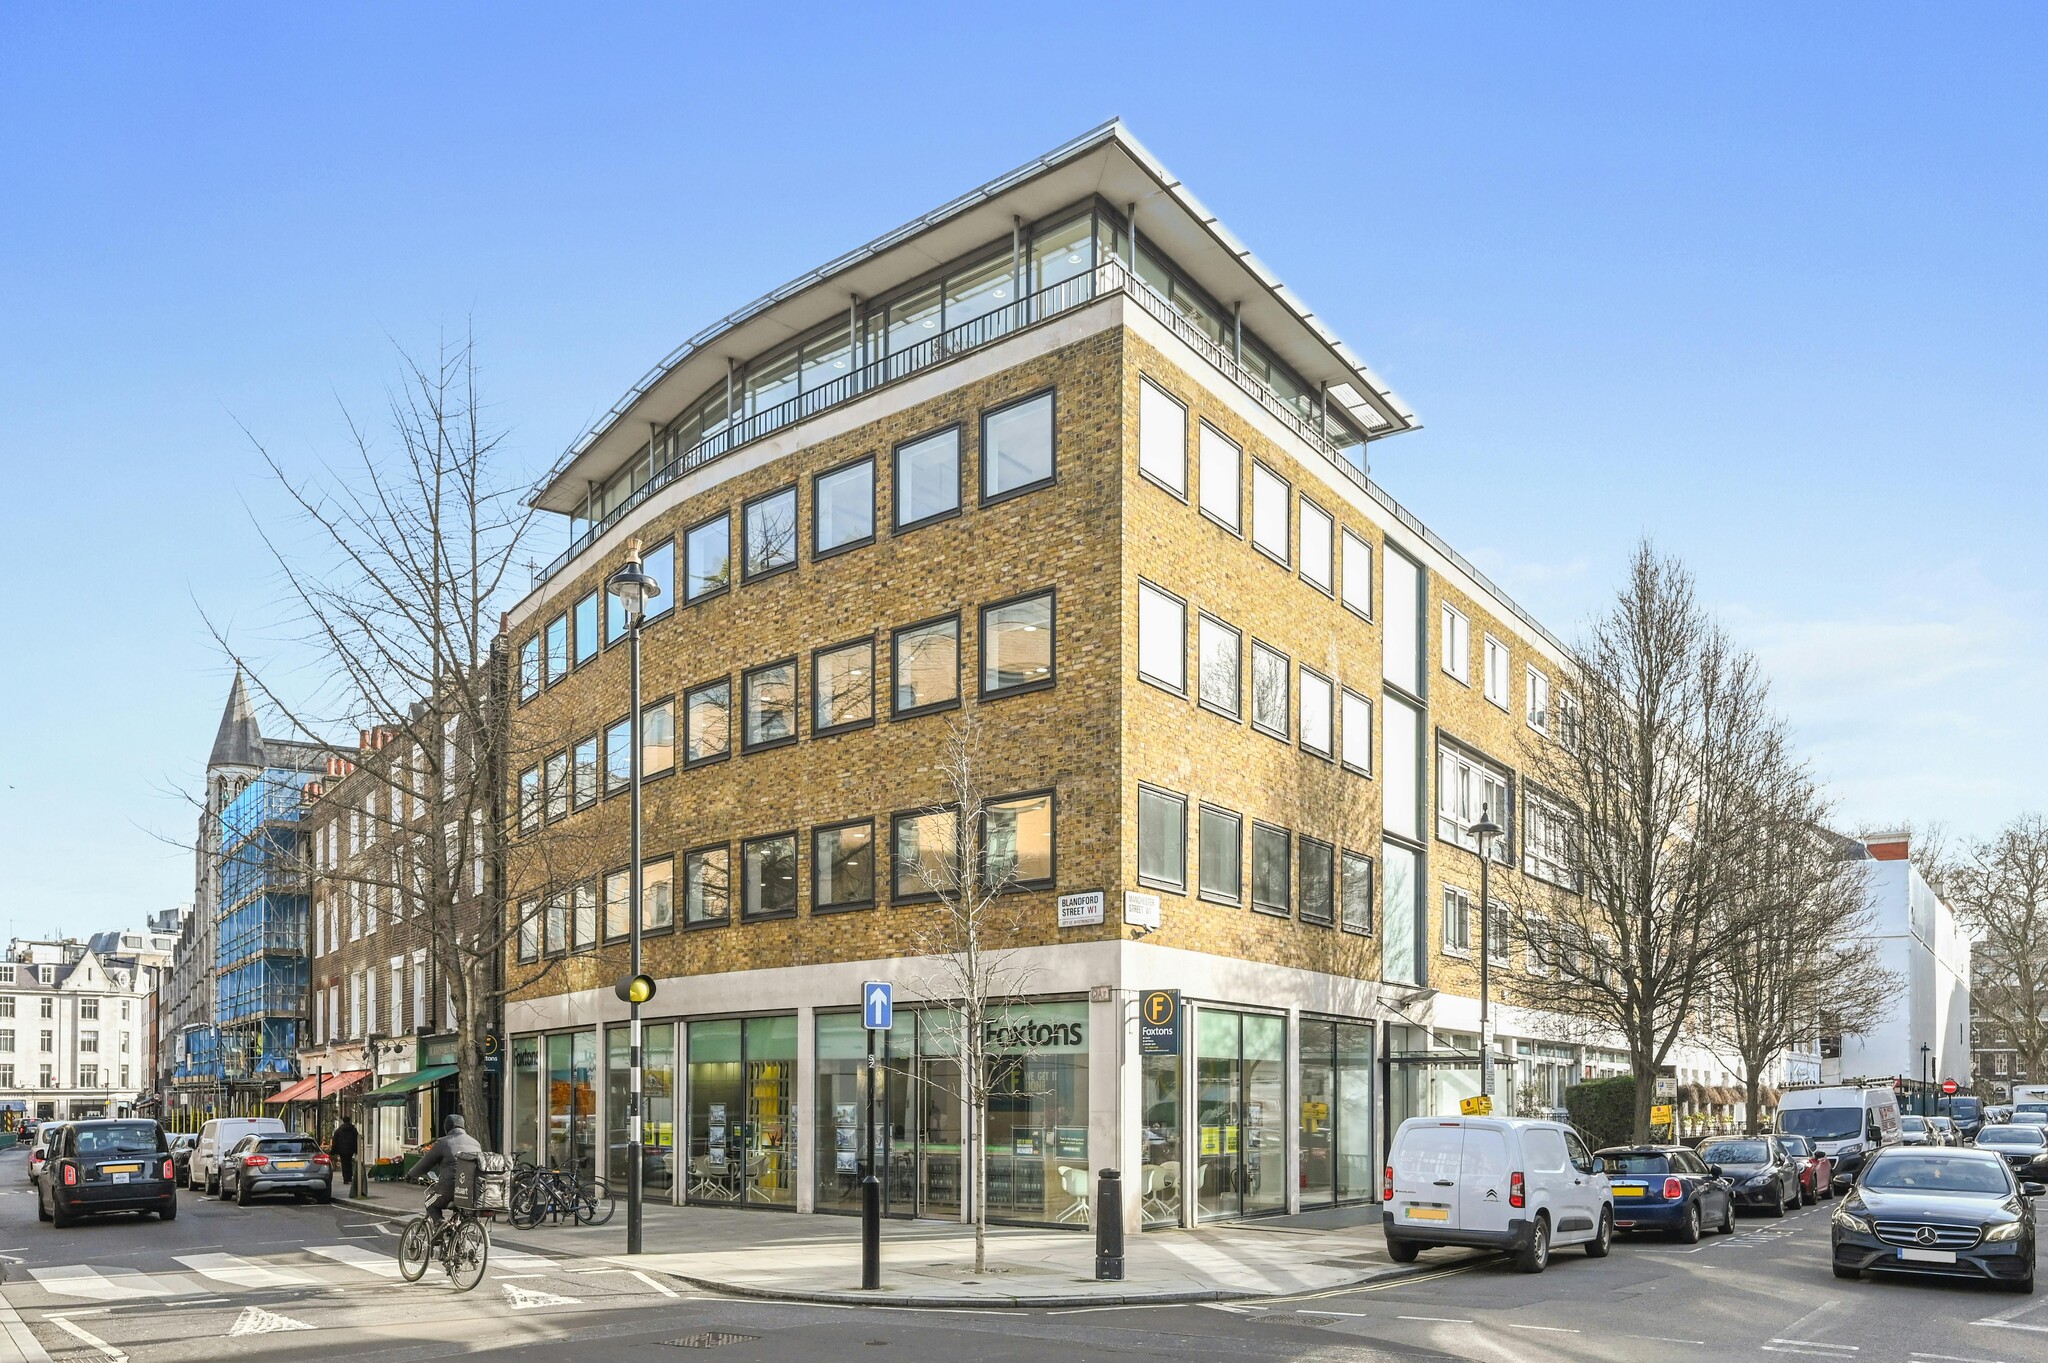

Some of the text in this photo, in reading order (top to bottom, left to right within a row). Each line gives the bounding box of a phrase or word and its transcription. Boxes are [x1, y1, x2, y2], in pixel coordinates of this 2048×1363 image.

[1061, 895, 1099, 907] BLANDFORD
[1128, 895, 1155, 906] MANCHESTER
[1061, 905, 1098, 917] STREET W1
[1128, 904, 1144, 914] STREET
[1152, 997, 1165, 1020] F
[985, 1018, 1083, 1048] Foxtons
[1142, 1026, 1173, 1036] Foxtons
[1037, 1071, 1049, 1081] GET
